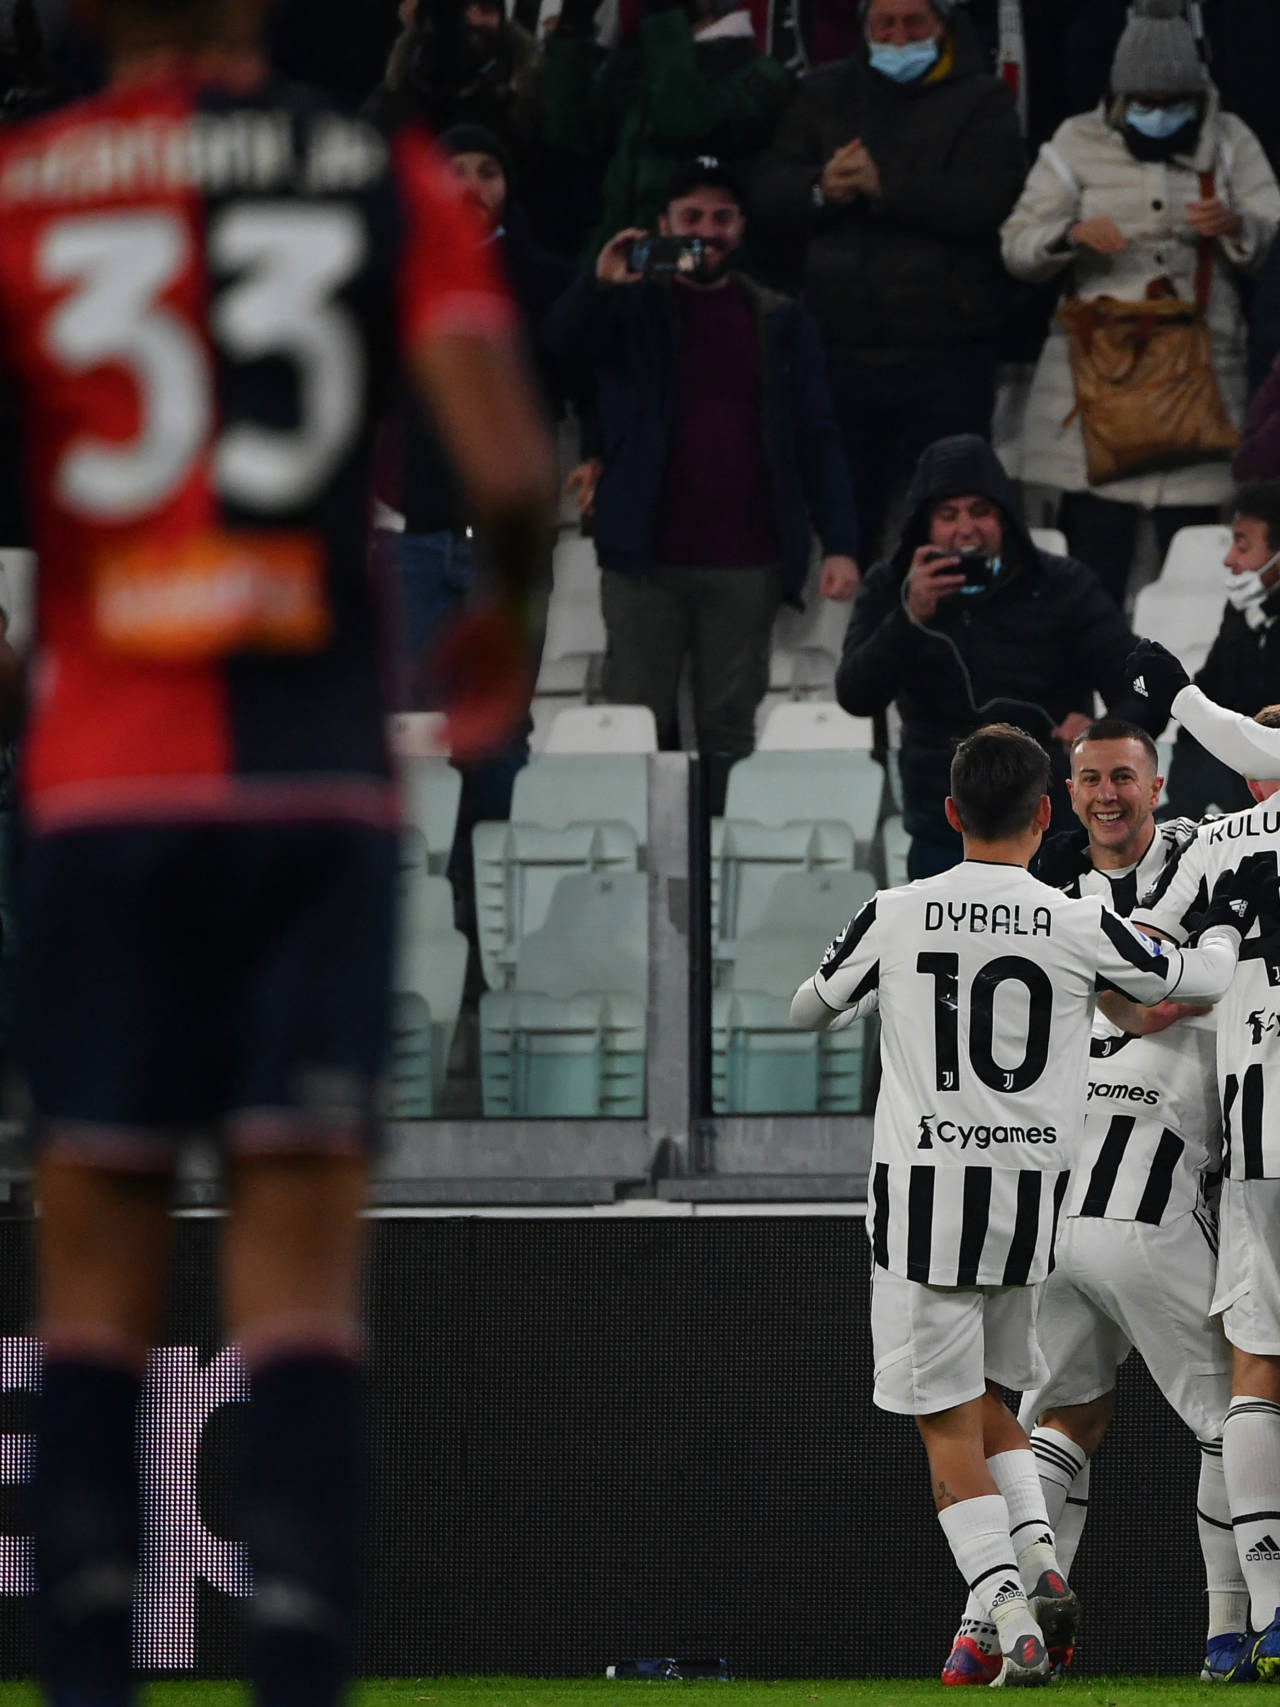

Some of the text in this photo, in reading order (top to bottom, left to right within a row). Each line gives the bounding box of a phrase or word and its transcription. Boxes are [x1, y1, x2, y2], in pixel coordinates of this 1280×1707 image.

[35, 205, 367, 521] 33
[925, 902, 1052, 936] DYBALA
[917, 952, 1053, 1093] 10
[1087, 1081, 1160, 1105] games
[937, 1121, 1057, 1150] Cygames
